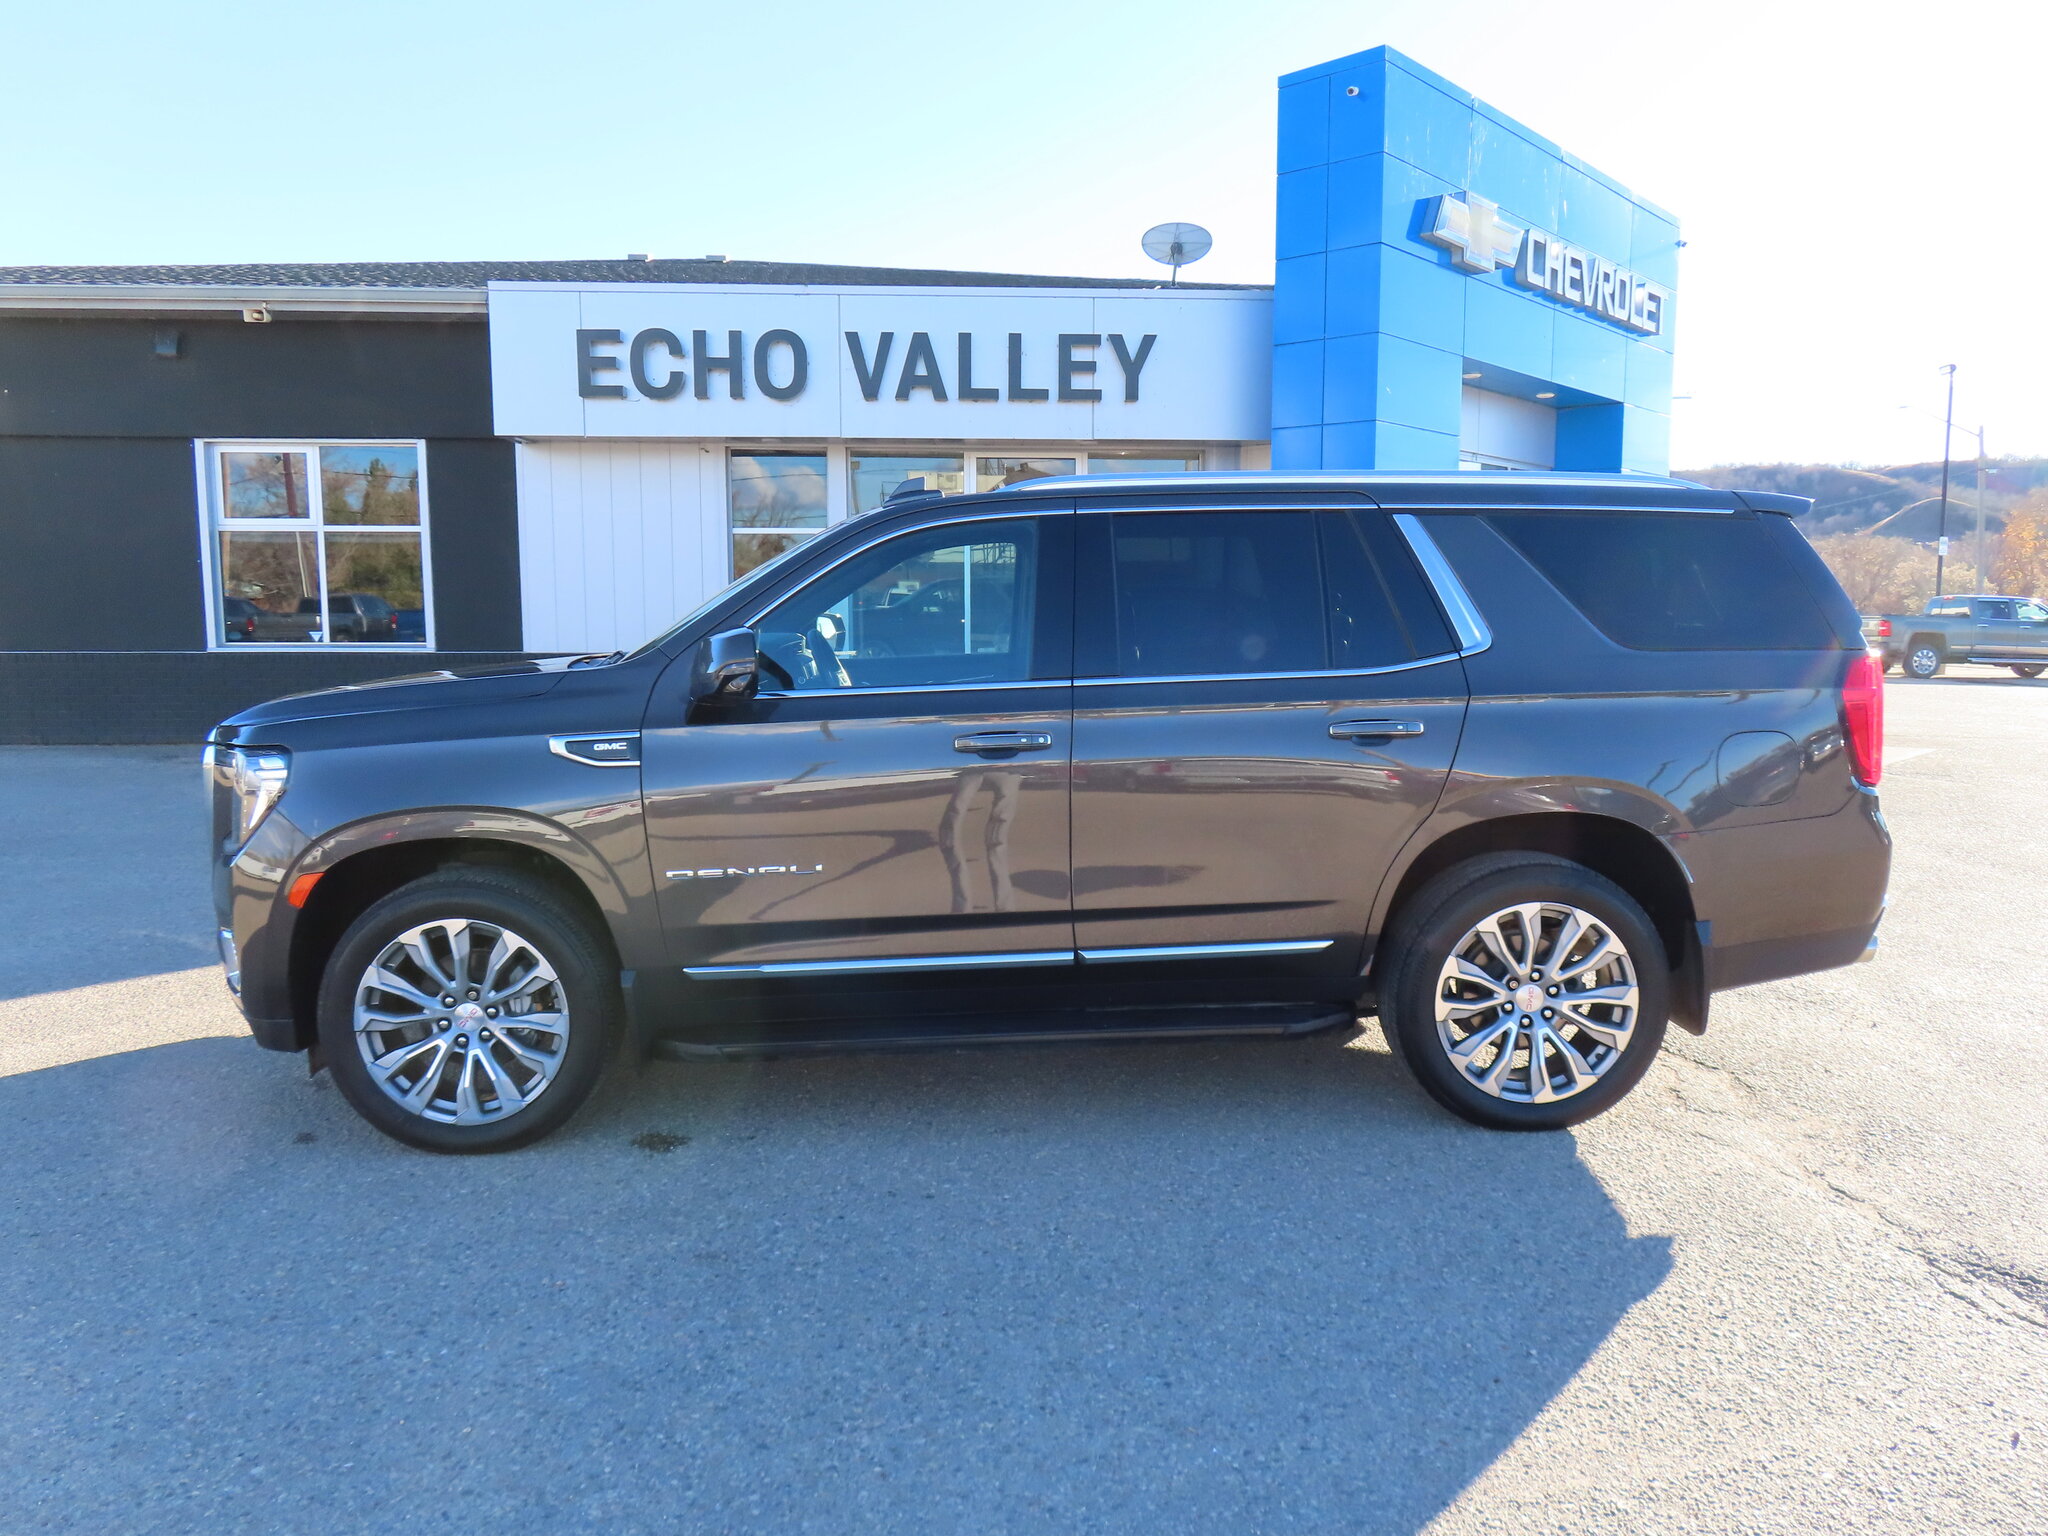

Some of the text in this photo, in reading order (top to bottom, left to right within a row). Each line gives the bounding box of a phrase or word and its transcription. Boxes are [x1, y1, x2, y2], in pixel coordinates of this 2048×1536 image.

[1518, 227, 1668, 335] CHEVROLET
[576, 327, 1158, 403] ECHO VALLEY
[593, 741, 628, 751] GMC
[665, 864, 823, 880] DENALI
[1525, 986, 1535, 1010] GMC
